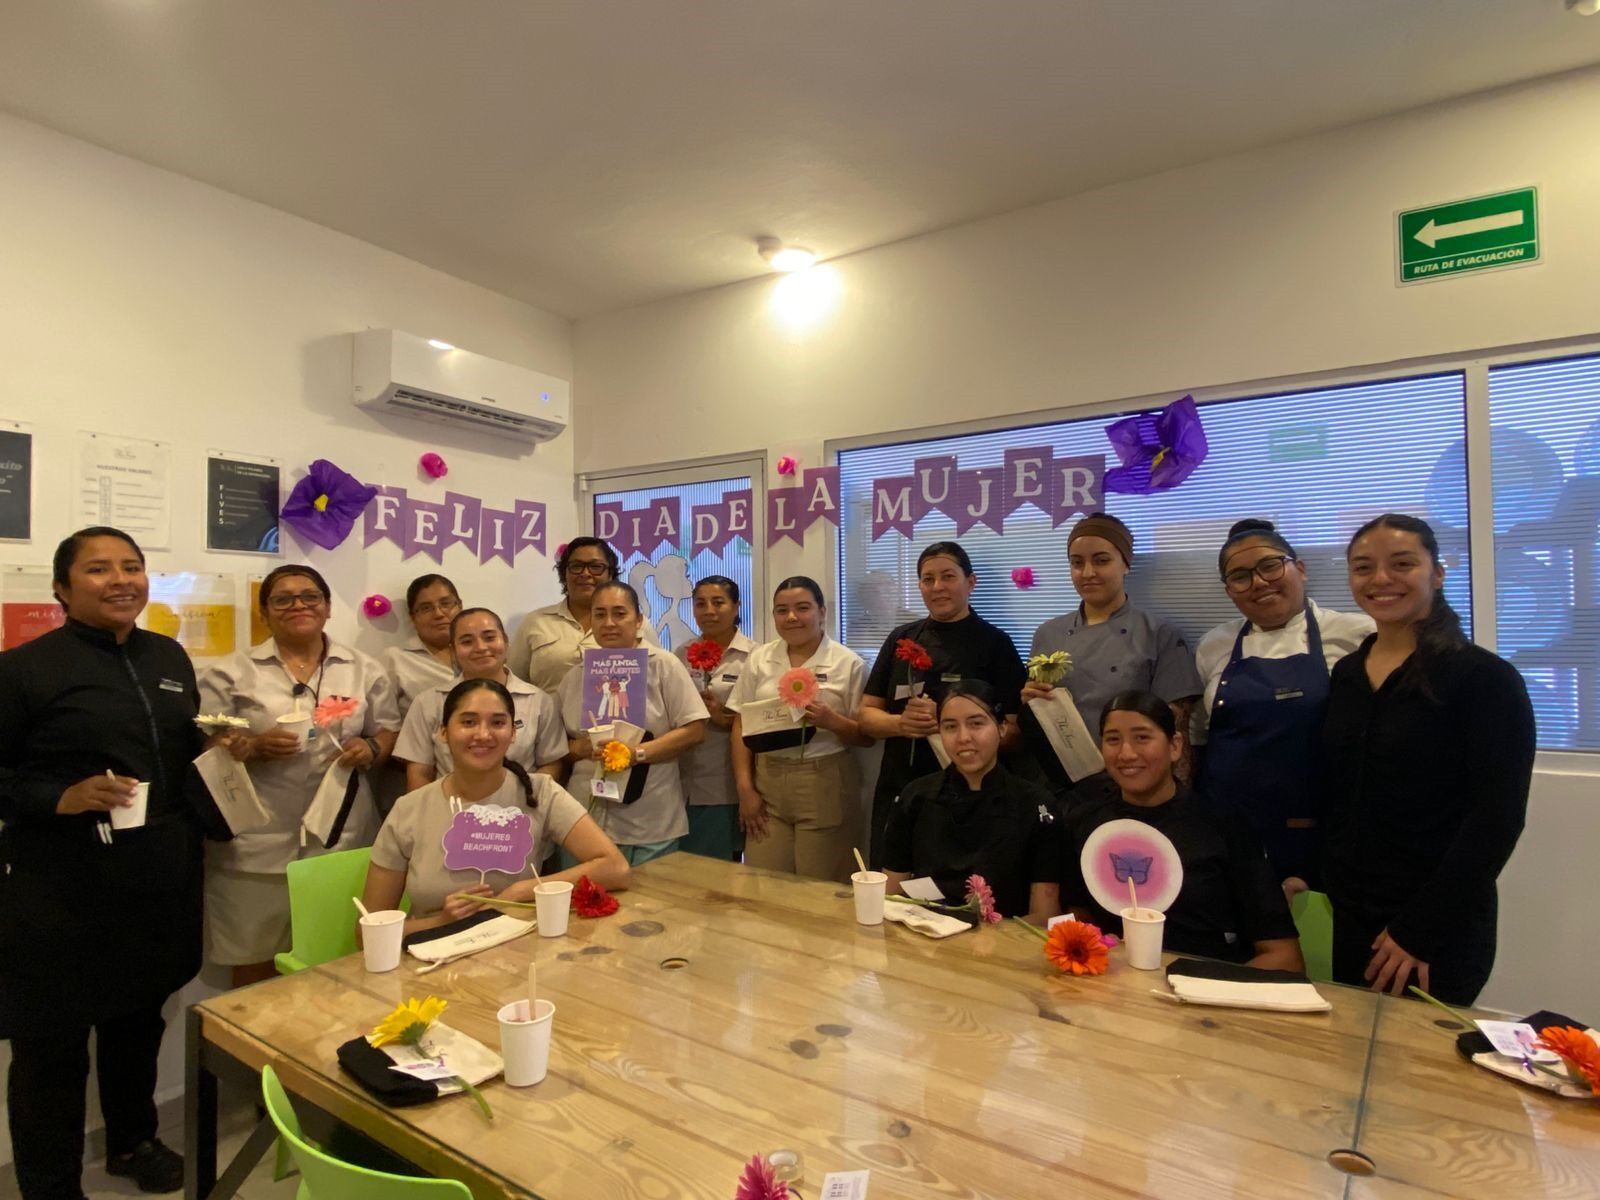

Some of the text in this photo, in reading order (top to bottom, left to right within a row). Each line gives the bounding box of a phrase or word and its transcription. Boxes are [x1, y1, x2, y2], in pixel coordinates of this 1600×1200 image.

[1413, 248, 1525, 275] RUTA DE EVACUACIÓN
[373, 457, 1097, 550] FELIZ DIA DE LA MUJER
[463, 842, 514, 853] BEACHFRONT
